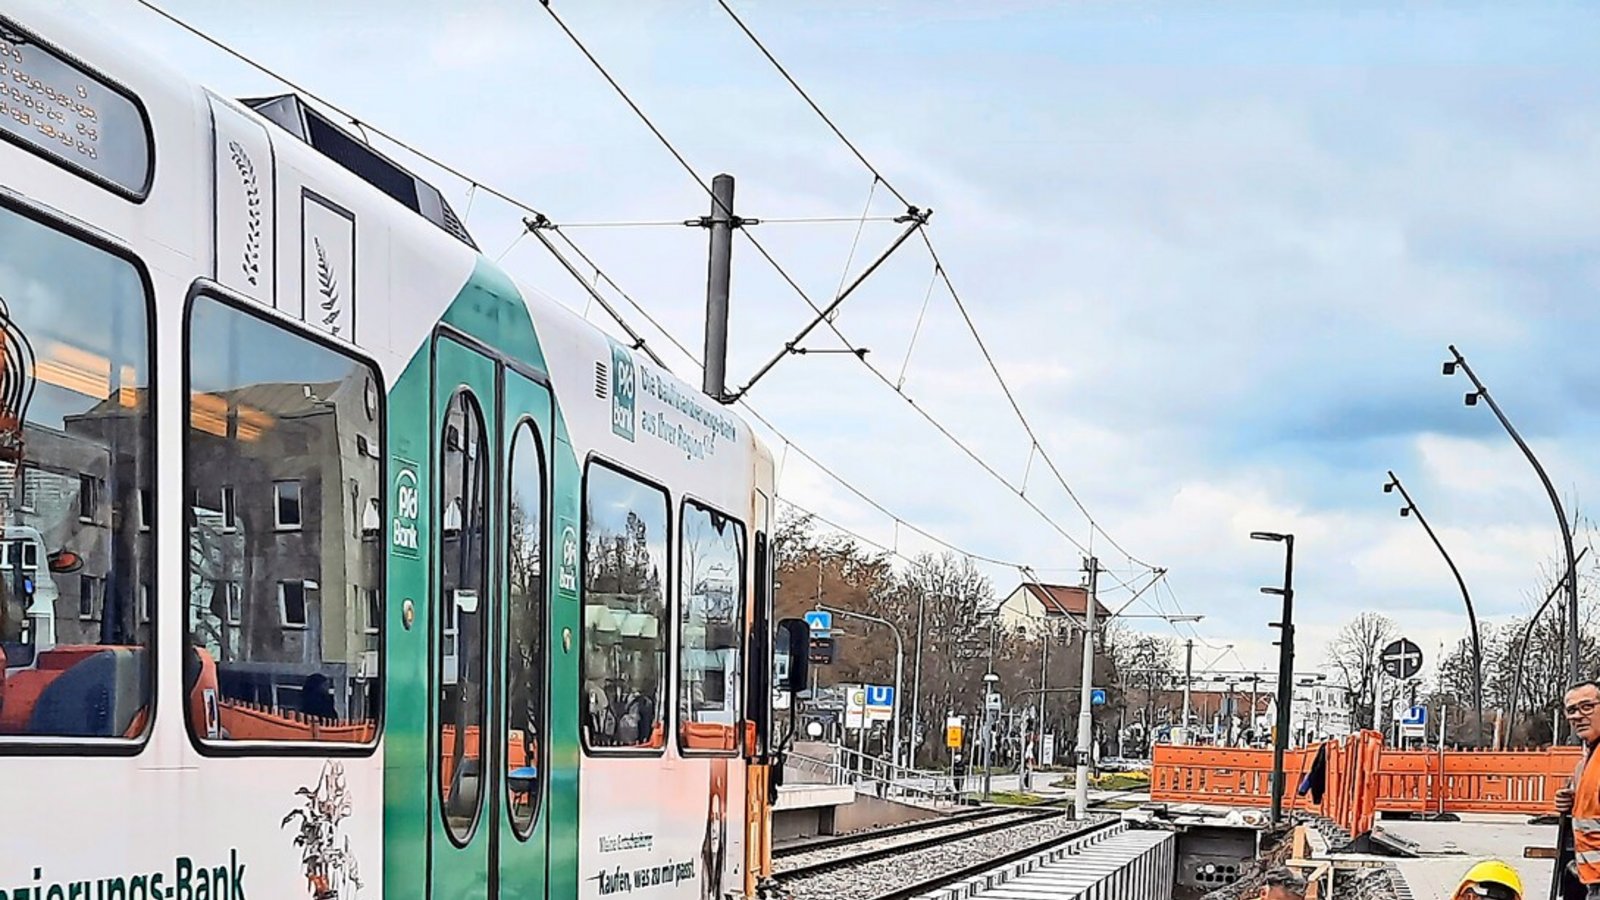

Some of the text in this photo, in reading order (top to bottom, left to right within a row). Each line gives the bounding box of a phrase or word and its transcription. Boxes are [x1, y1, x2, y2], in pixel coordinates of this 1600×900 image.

[393, 517, 418, 549] Bank
[872, 687, 888, 703] U
[633, 868, 650, 888] was
[651, 867, 661, 886] zu
